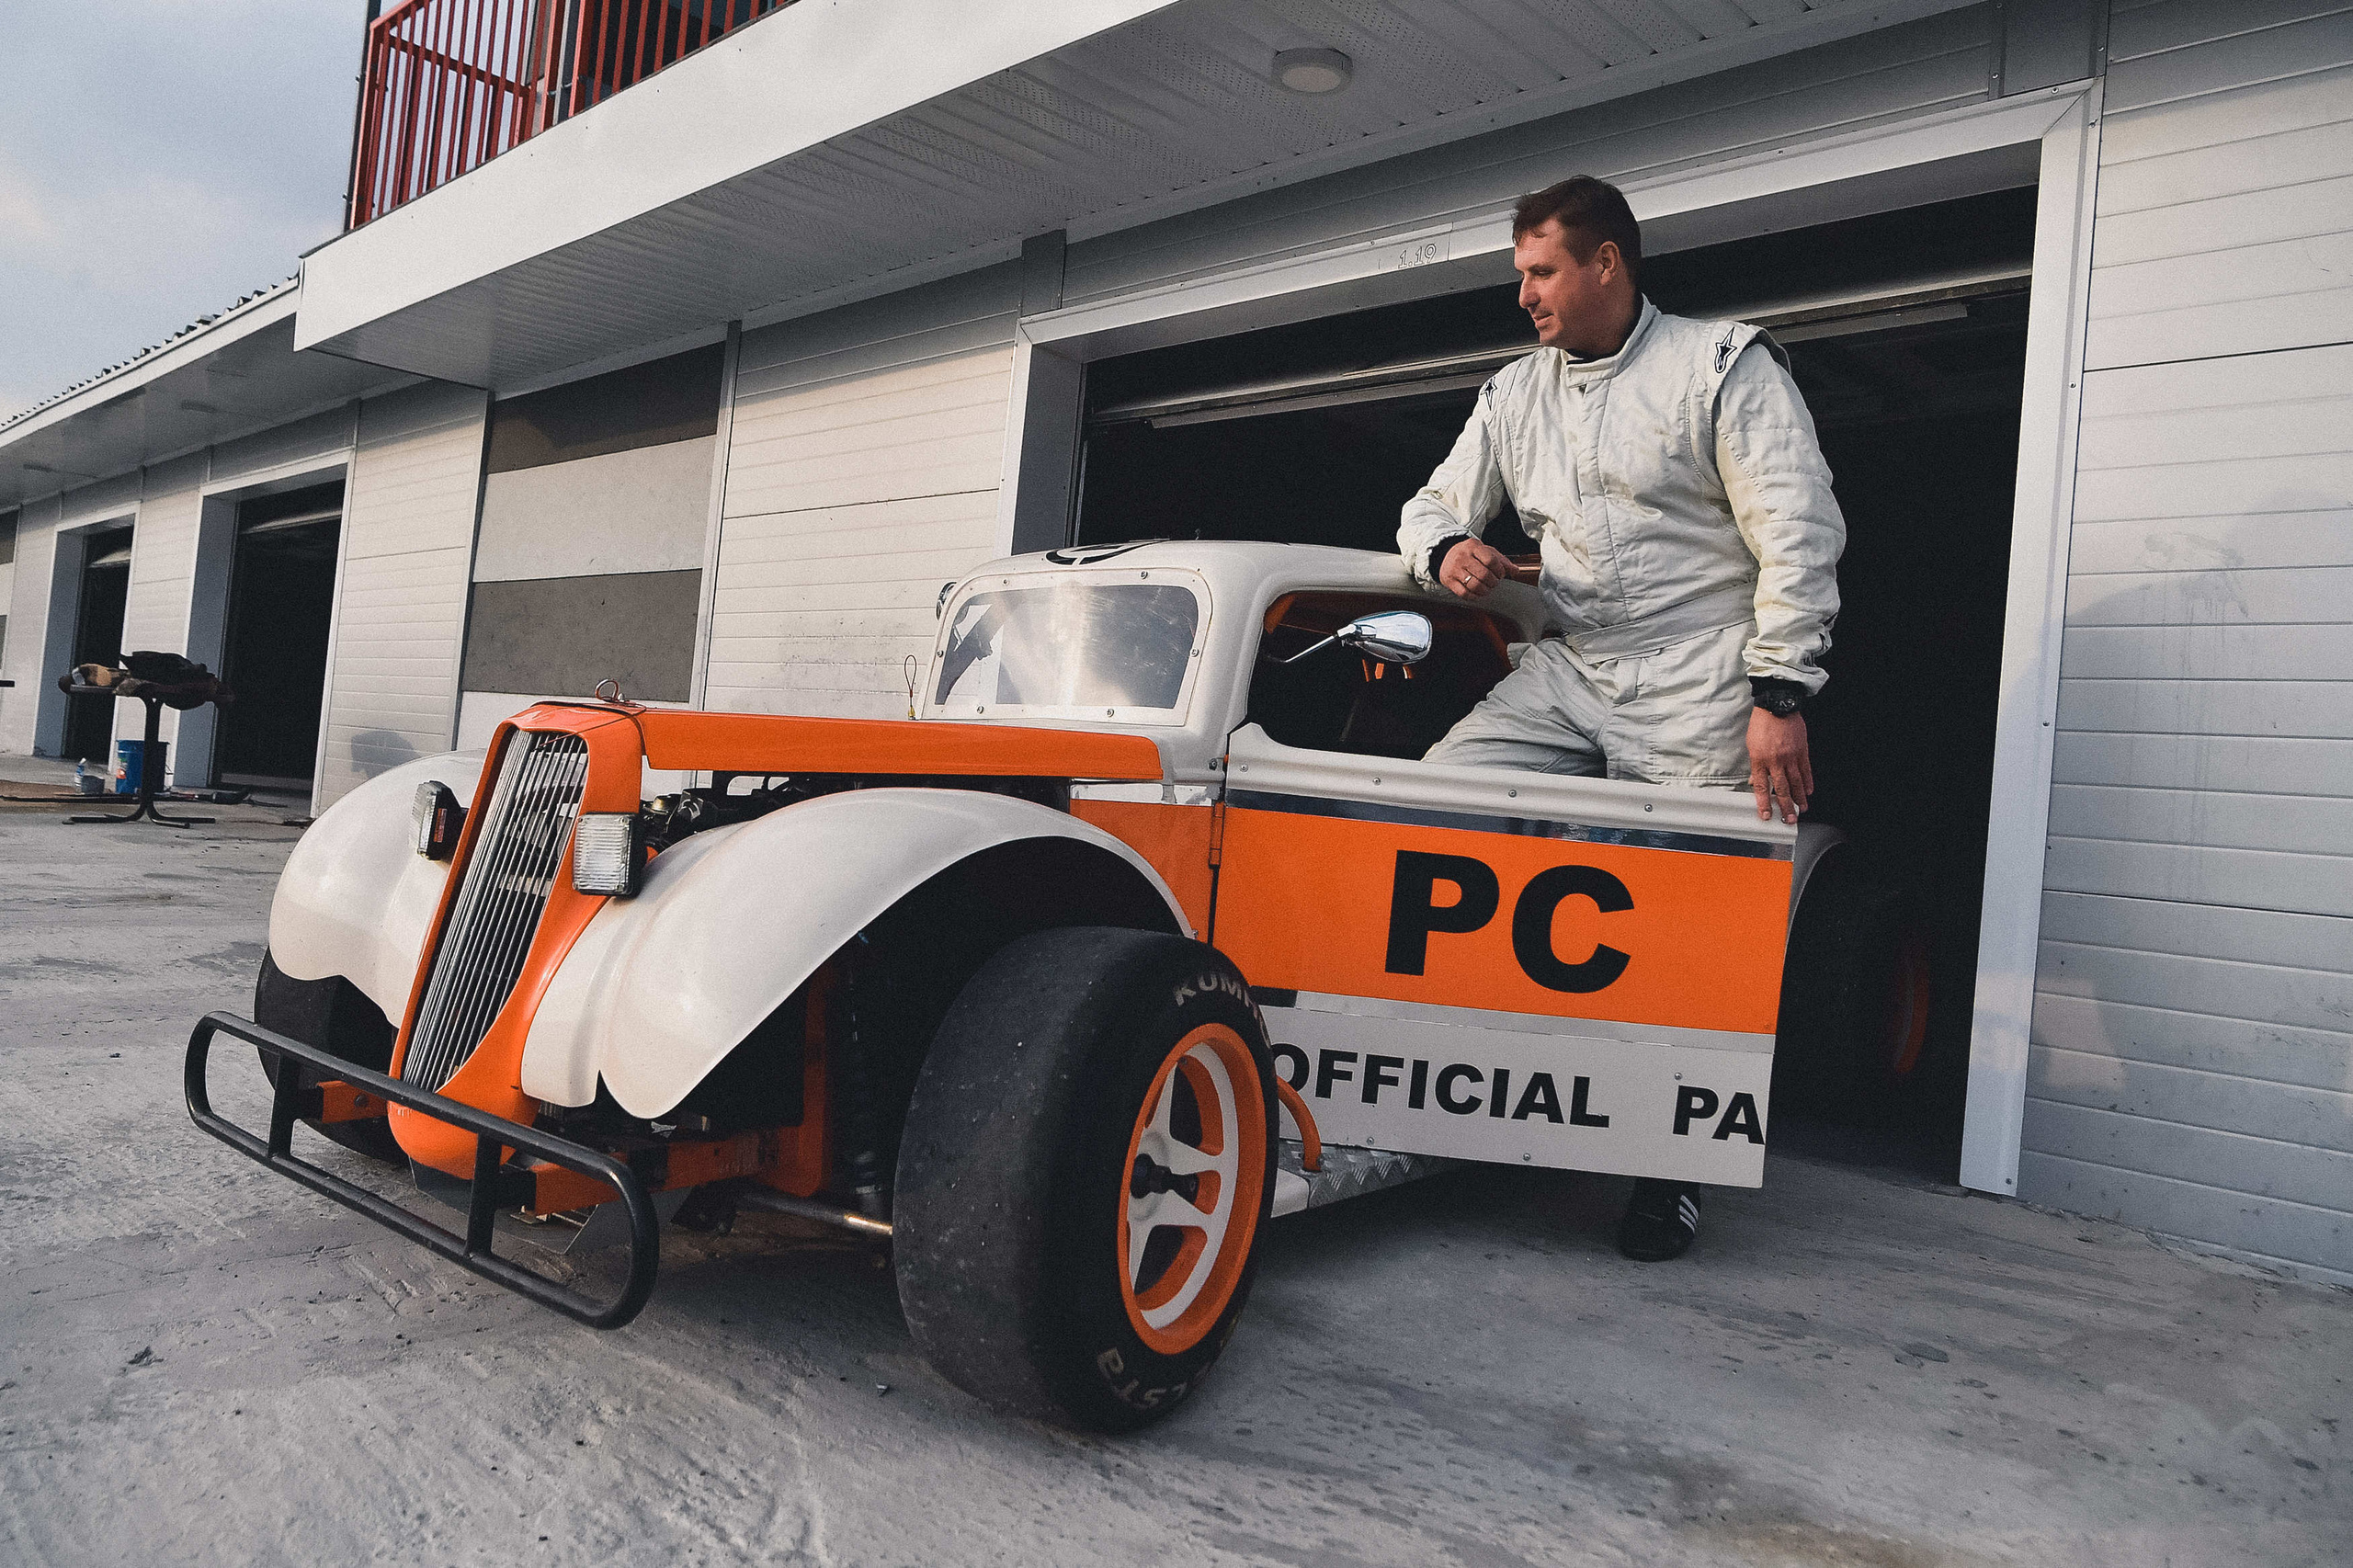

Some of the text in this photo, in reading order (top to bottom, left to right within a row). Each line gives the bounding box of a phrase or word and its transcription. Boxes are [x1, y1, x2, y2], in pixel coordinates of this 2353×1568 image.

[1397, 243, 1438, 269] 1.19
[1384, 849, 1635, 994] PC
[1270, 1042, 1766, 1145] OFFICIAL PA
